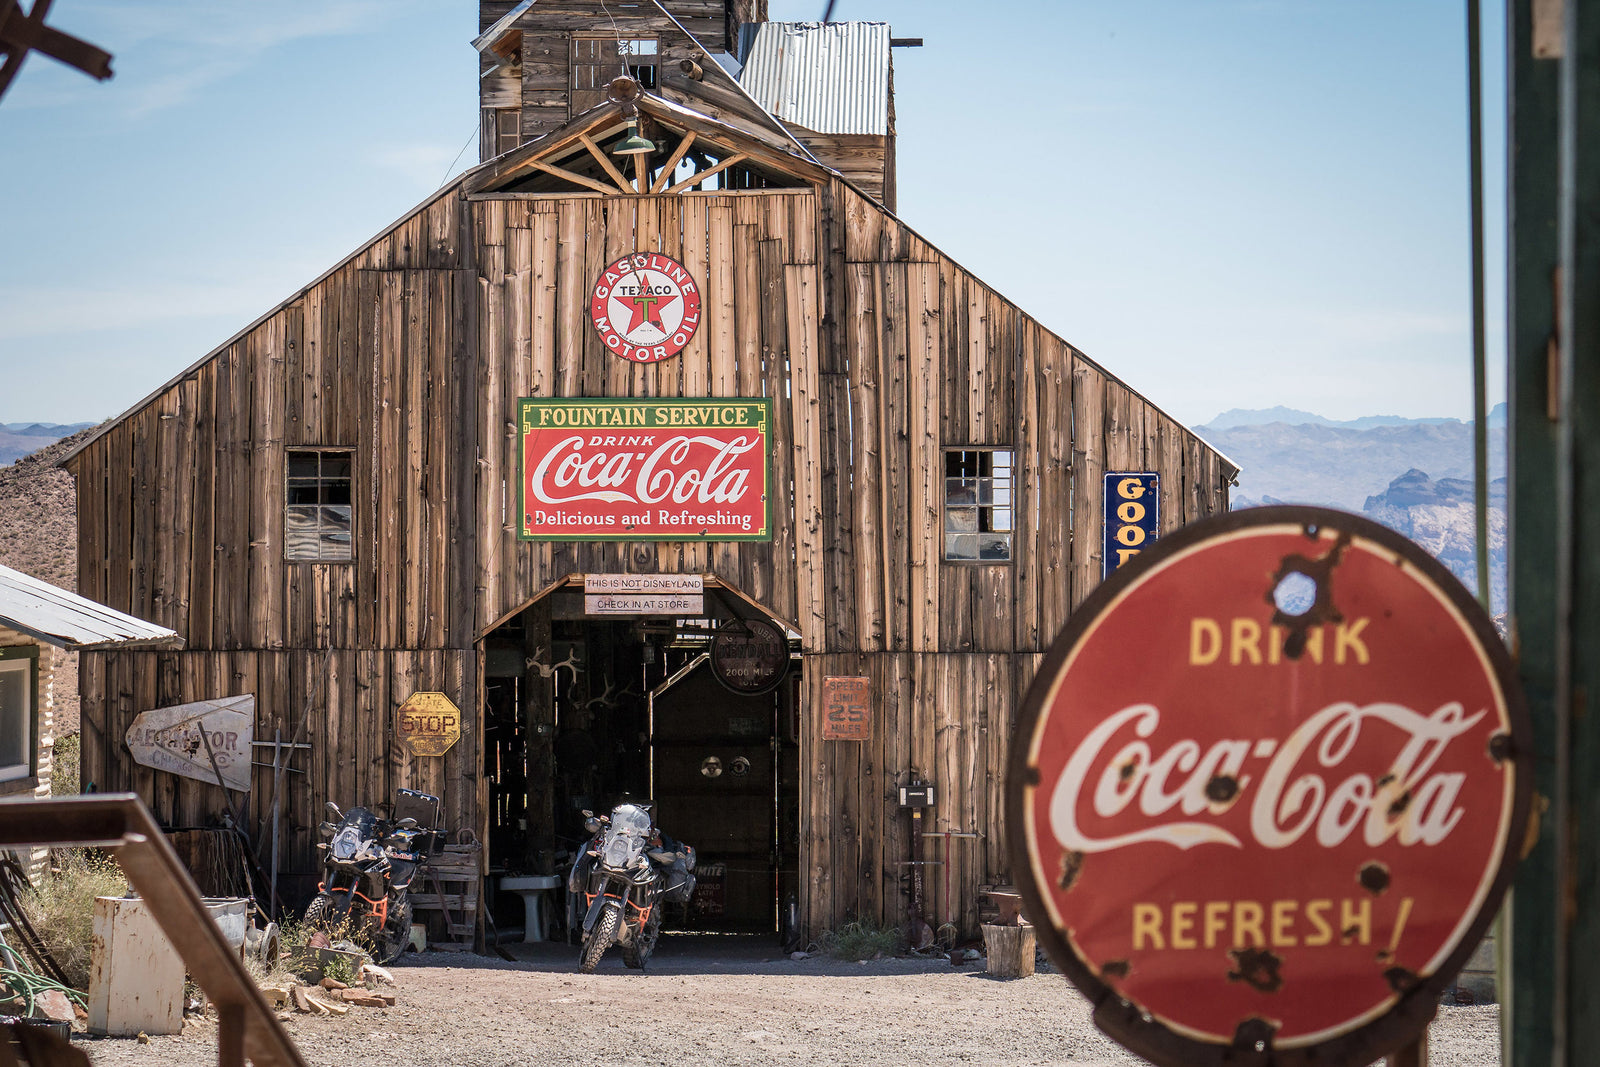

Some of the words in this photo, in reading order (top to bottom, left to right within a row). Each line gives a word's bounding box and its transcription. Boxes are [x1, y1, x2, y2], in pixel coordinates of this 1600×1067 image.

[595, 255, 696, 299] GASOLINE
[620, 286, 671, 296] TEXACO
[633, 297, 658, 322] T
[595, 316, 667, 361] MOTOR
[673, 312, 698, 346] OIL
[539, 407, 646, 425] FOUNTAIN
[655, 407, 748, 425] SERVICE
[588, 436, 656, 446] DRINK
[532, 435, 760, 504] Coca-Cola
[535, 510, 615, 525] Delicious
[621, 510, 651, 525] and
[658, 510, 752, 530] Refreshing
[586, 580, 608, 588] THIS
[610, 580, 619, 588] IS
[621, 580, 642, 588] NOT
[643, 580, 701, 588] DISNEYLAND
[597, 600, 629, 609] CHECK
[632, 600, 641, 609] IN
[643, 600, 655, 609] AT
[658, 600, 689, 609] STORE
[829, 681, 863, 691] SPEED
[833, 693, 859, 702] LIMIT
[829, 704, 864, 722] 25
[402, 715, 456, 732] STOP
[831, 724, 861, 734] MILES
[1049, 701, 1489, 853] Coca-Cola
